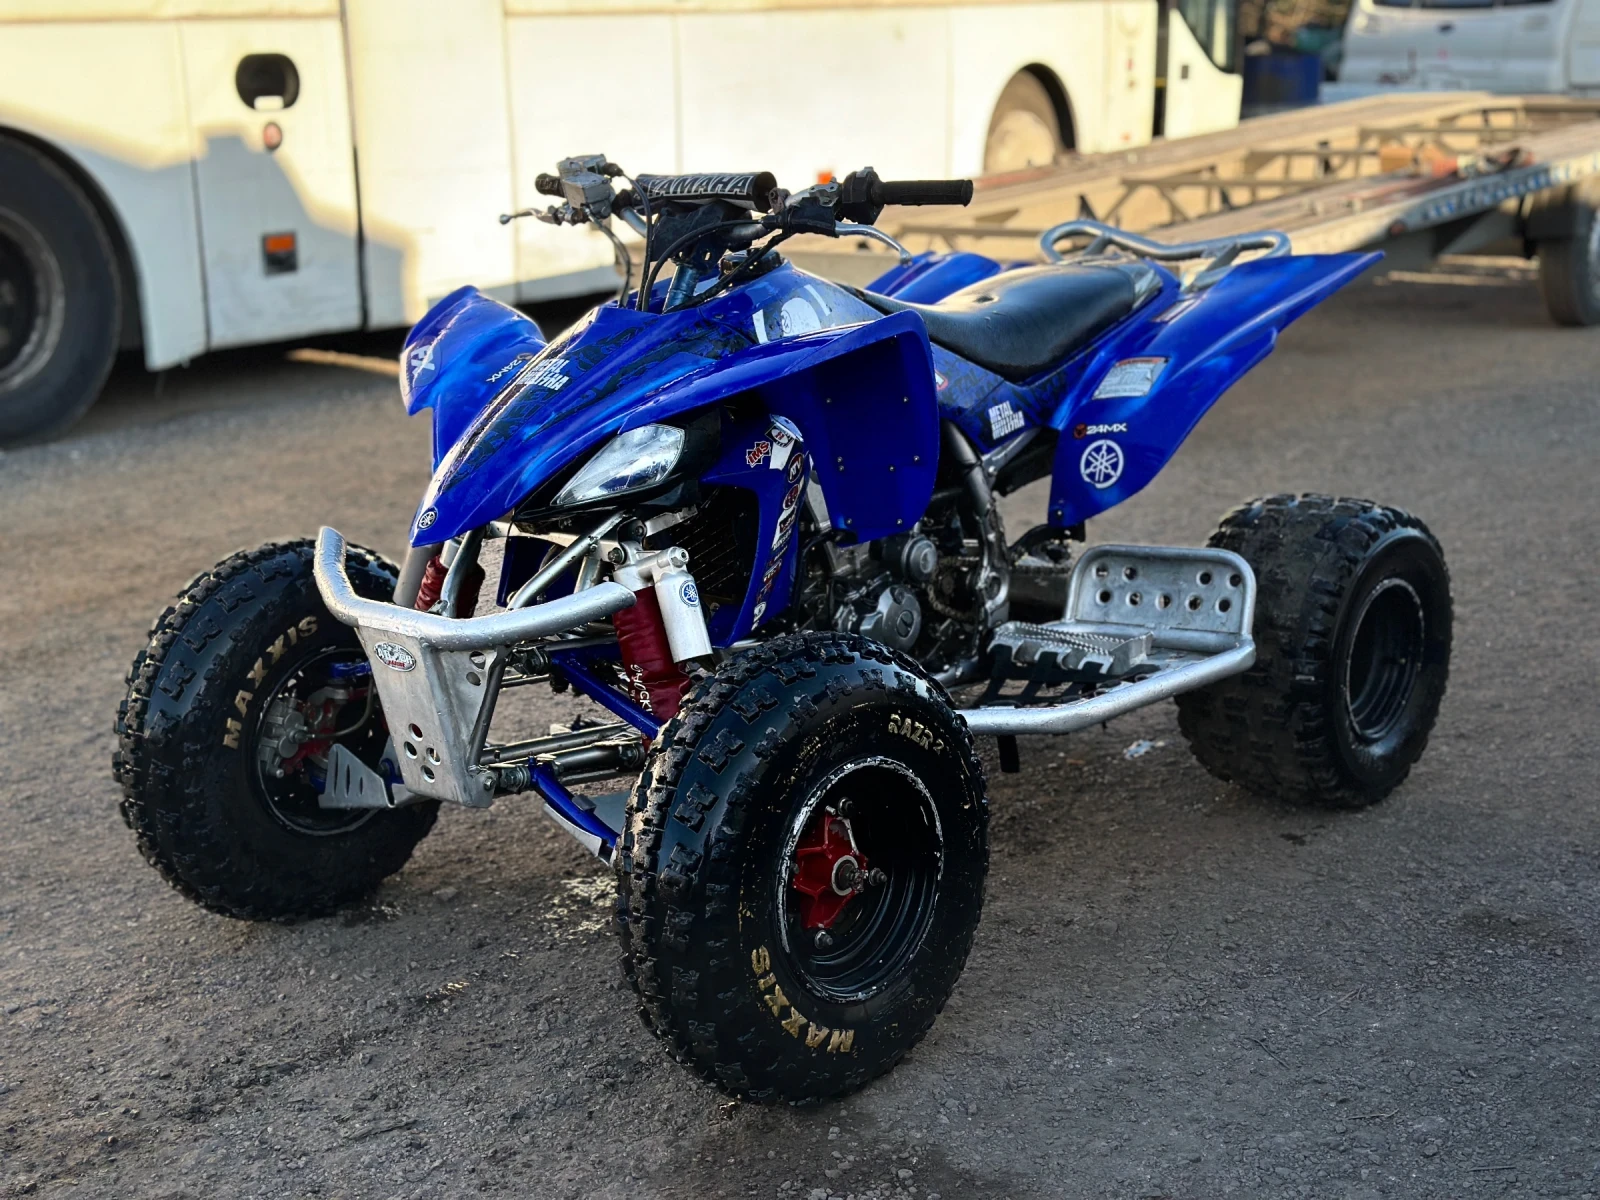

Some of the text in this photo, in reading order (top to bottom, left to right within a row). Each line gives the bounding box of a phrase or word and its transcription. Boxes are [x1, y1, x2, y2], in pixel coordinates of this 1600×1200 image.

[648, 176, 750, 197] YAMAHA
[485, 359, 524, 383] 24MX
[1086, 422, 1128, 435] 24MX
[747, 440, 770, 465] IMS
[222, 615, 319, 750] MAXXIS
[887, 713, 934, 751] RAZR
[750, 944, 856, 1053] MAXXIS
